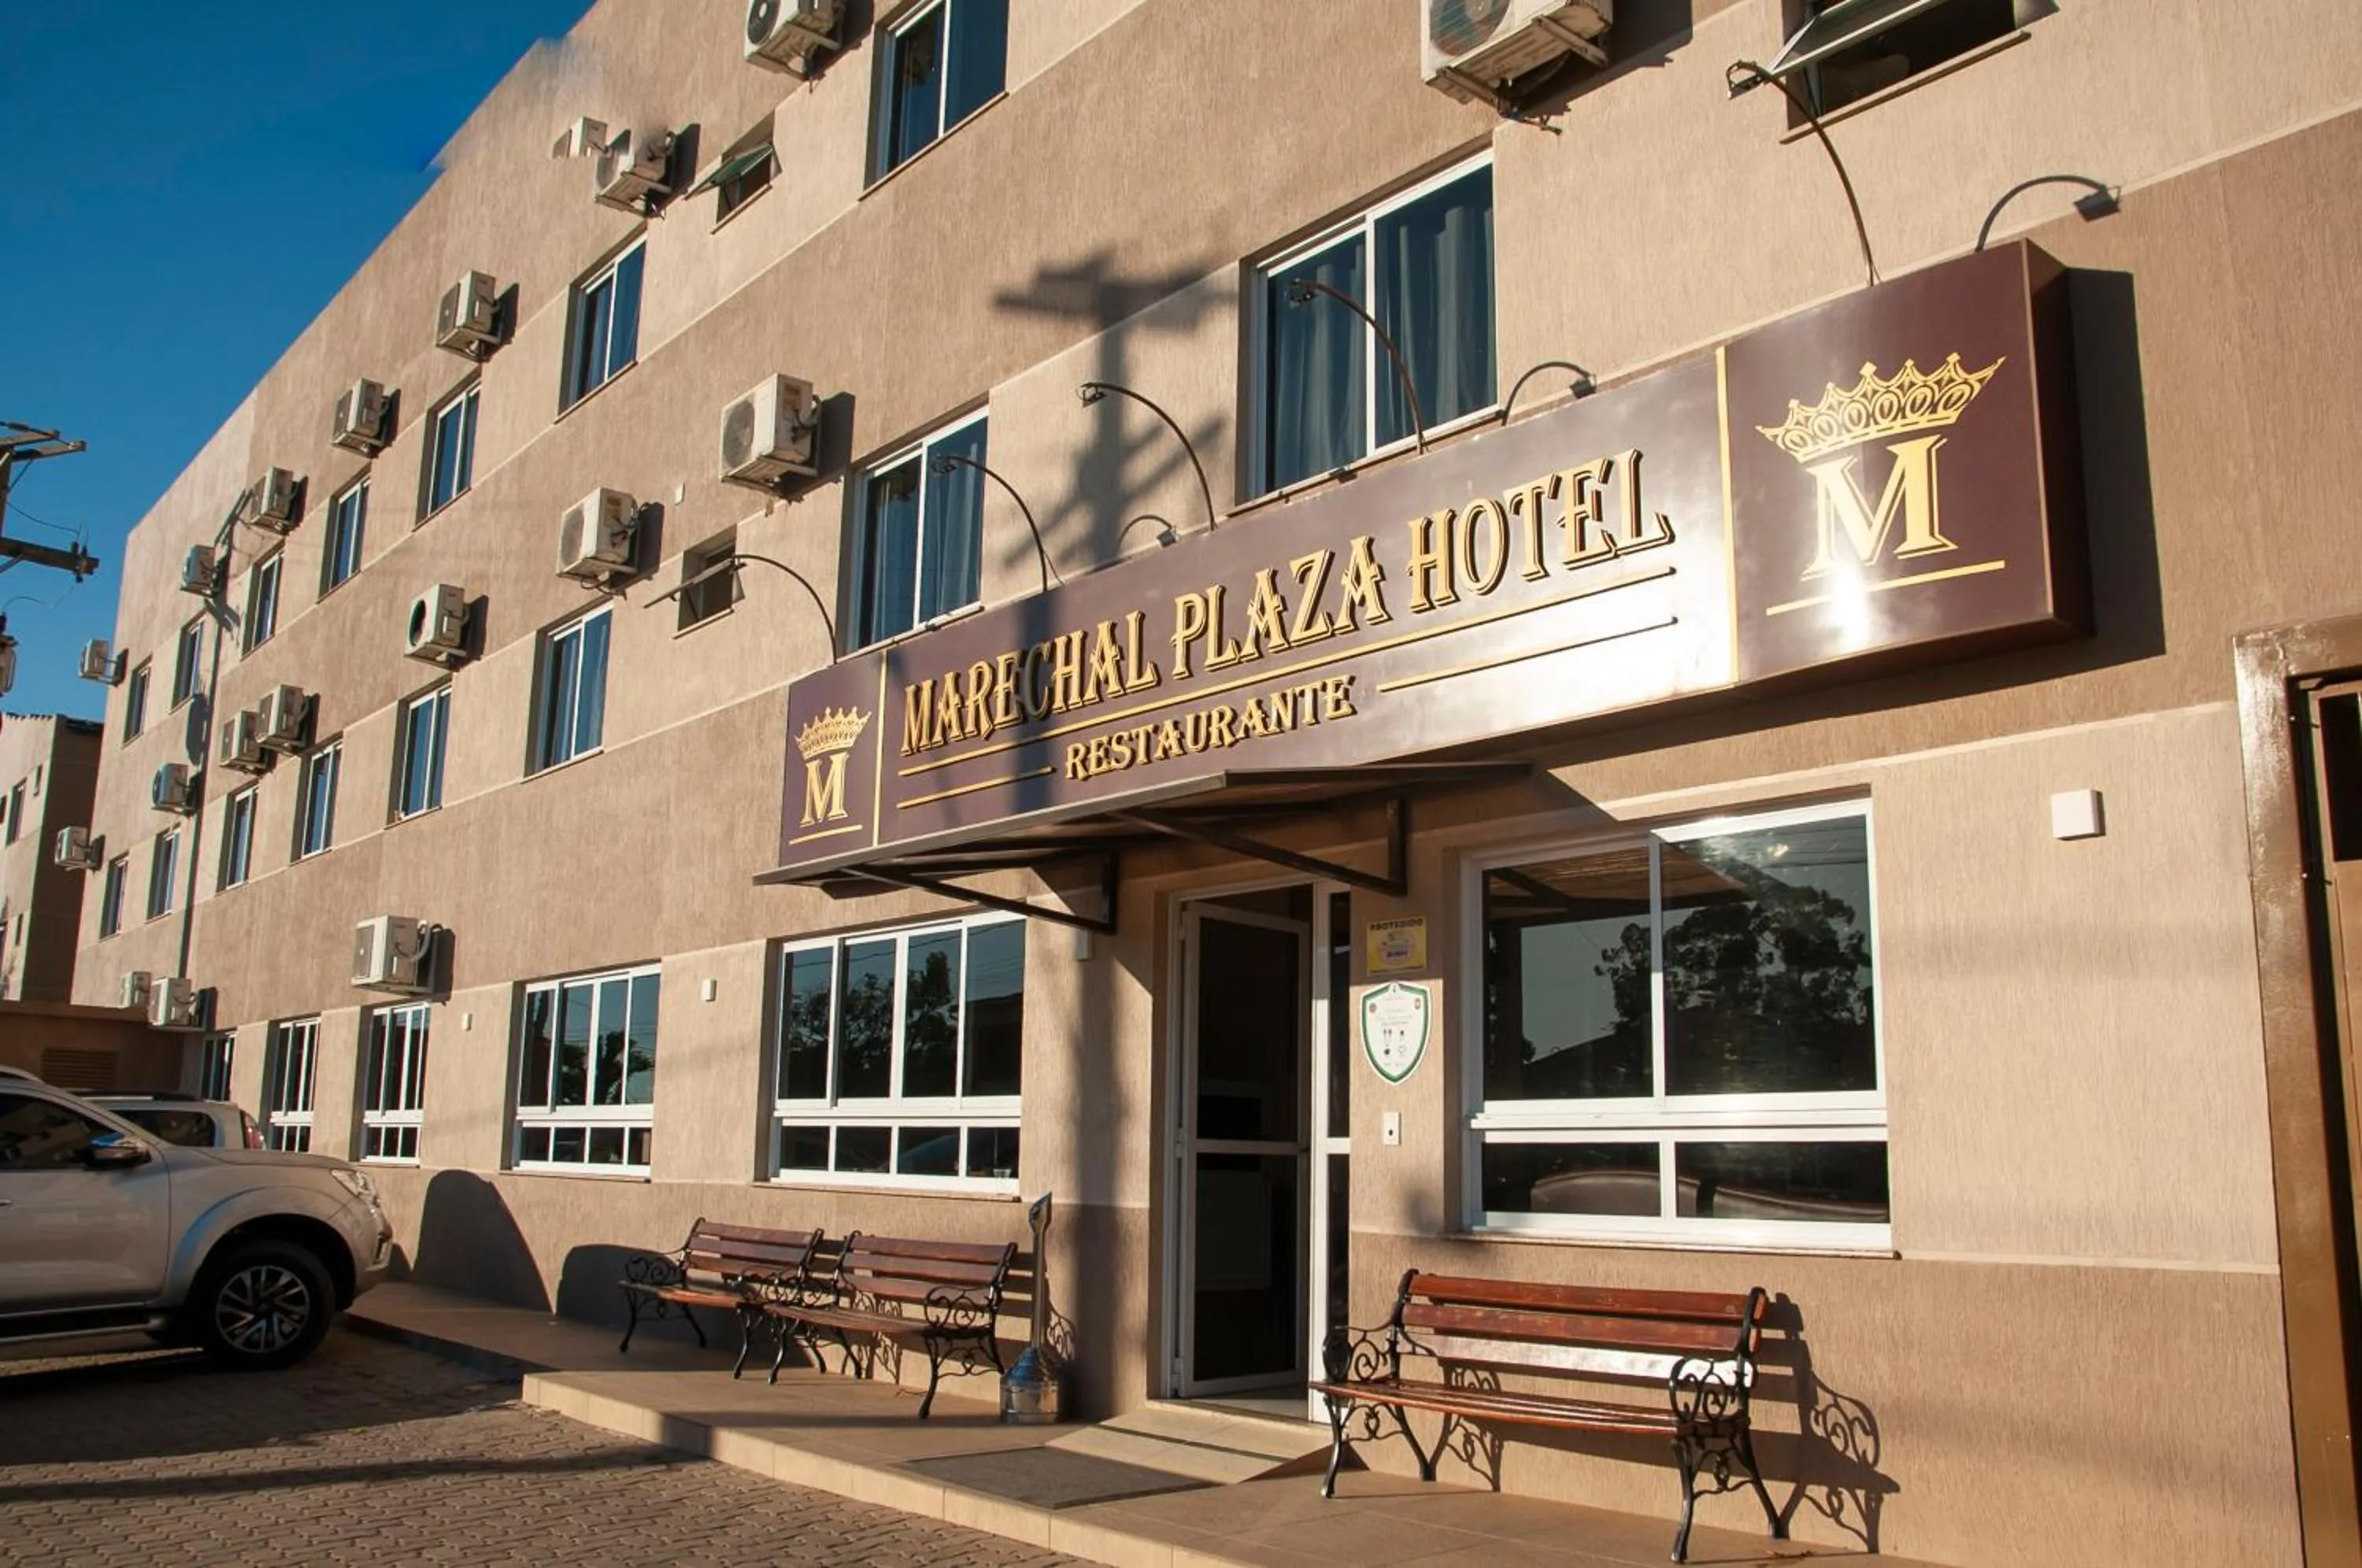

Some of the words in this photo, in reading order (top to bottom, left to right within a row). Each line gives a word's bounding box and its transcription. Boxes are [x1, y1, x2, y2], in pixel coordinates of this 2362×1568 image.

[1801, 434, 1958, 582] M
[899, 609, 1161, 756] MARECHAL
[1170, 535, 1393, 679] PLAZA
[1407, 448, 1675, 614] HOTEL
[799, 752, 851, 827] M
[1065, 674, 1357, 781] RESTAURANTE
